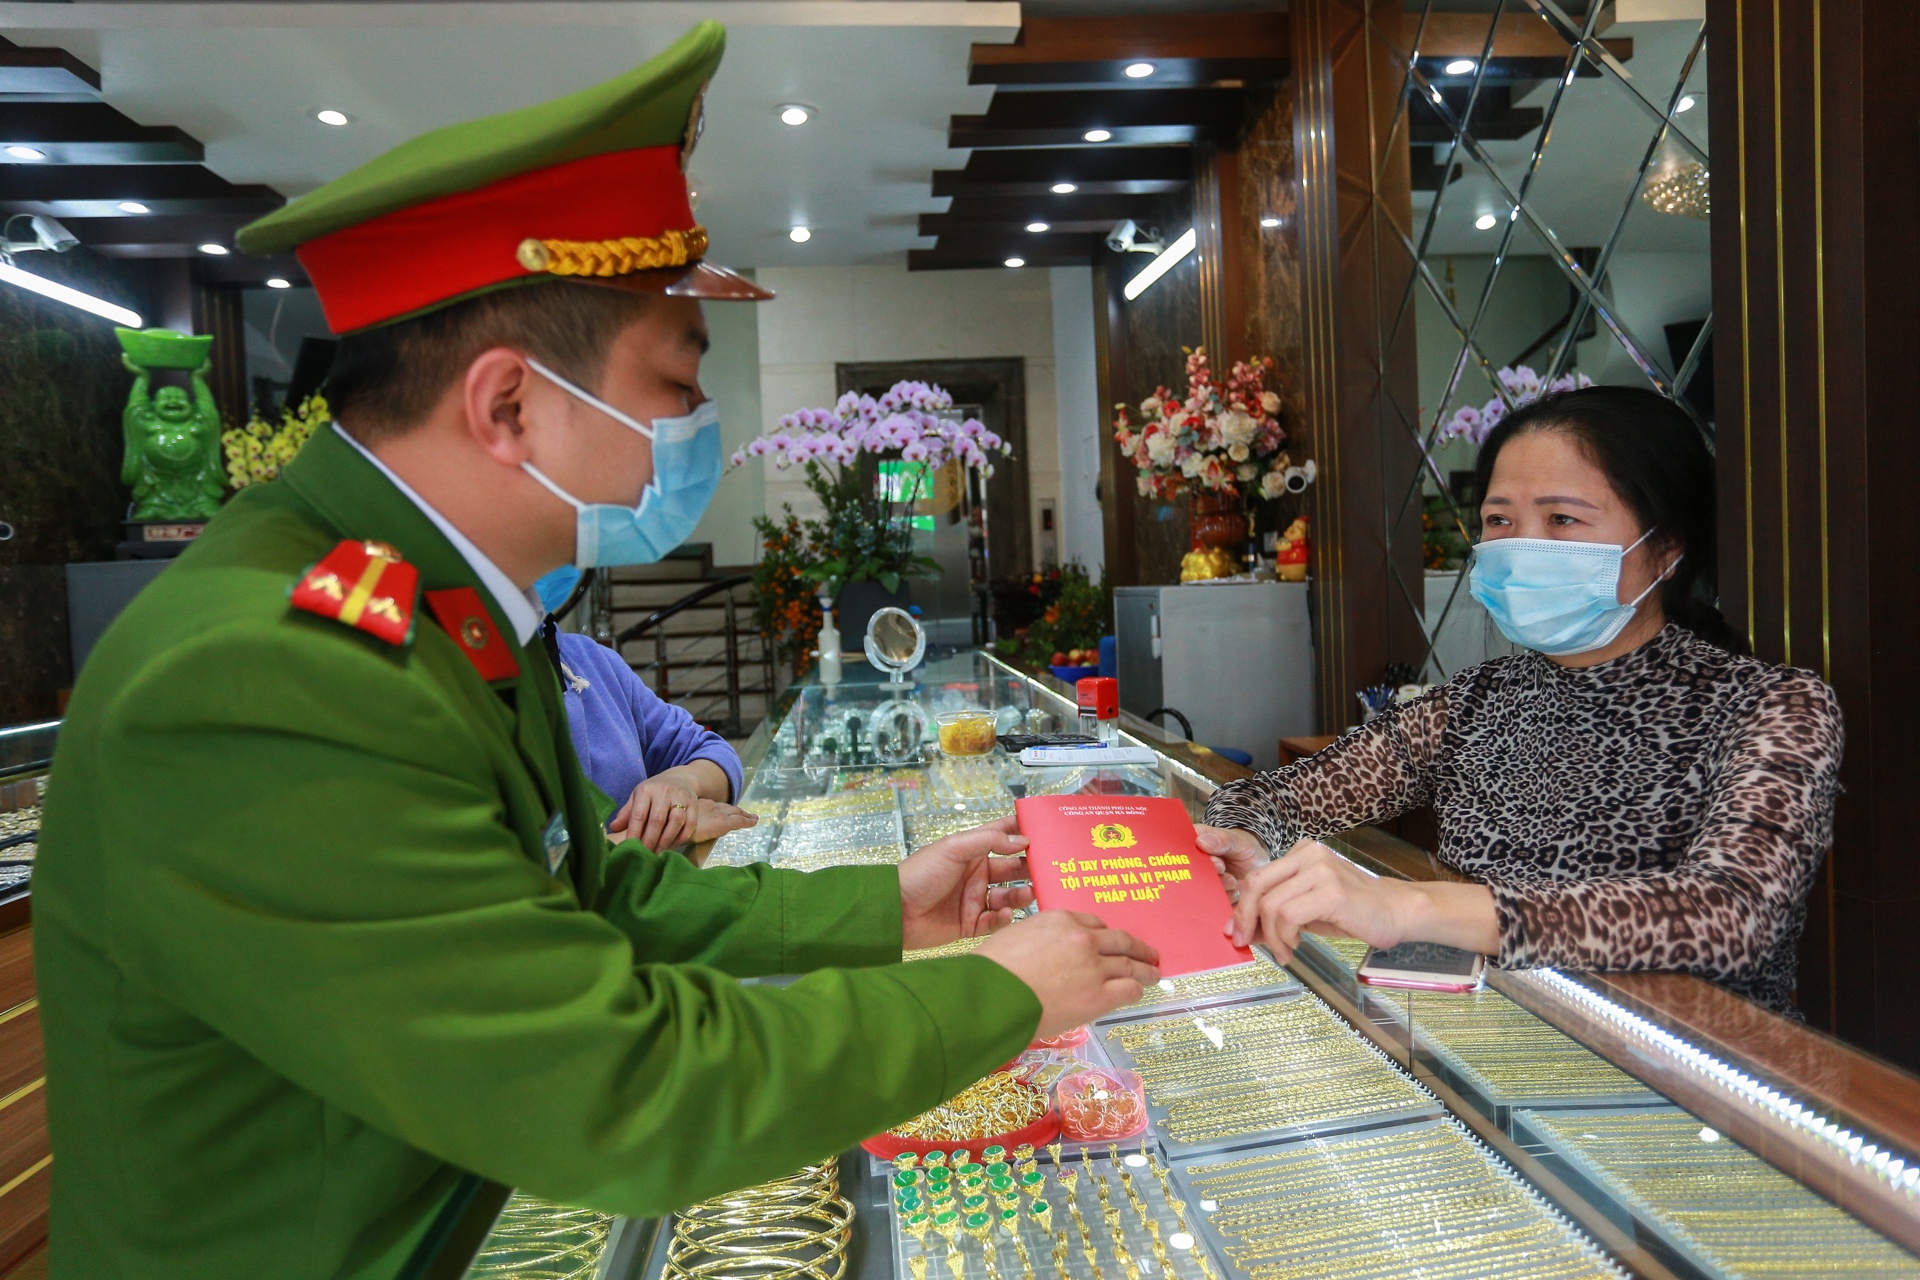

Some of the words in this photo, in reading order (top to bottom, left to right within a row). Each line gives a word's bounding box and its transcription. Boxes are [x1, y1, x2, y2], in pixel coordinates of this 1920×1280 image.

[1078, 860, 1099, 872] TAY
[1100, 856, 1147, 870] PHÒNG,
[1148, 852, 1190, 867] CHỐNG
[1060, 876, 1081, 890] TỘI
[1082, 874, 1120, 888] PHẠM
[1120, 871, 1139, 885] VÀ
[1139, 871, 1153, 884] VI
[1154, 869, 1192, 883] PHẠM
[1094, 888, 1127, 903] PHÁP
